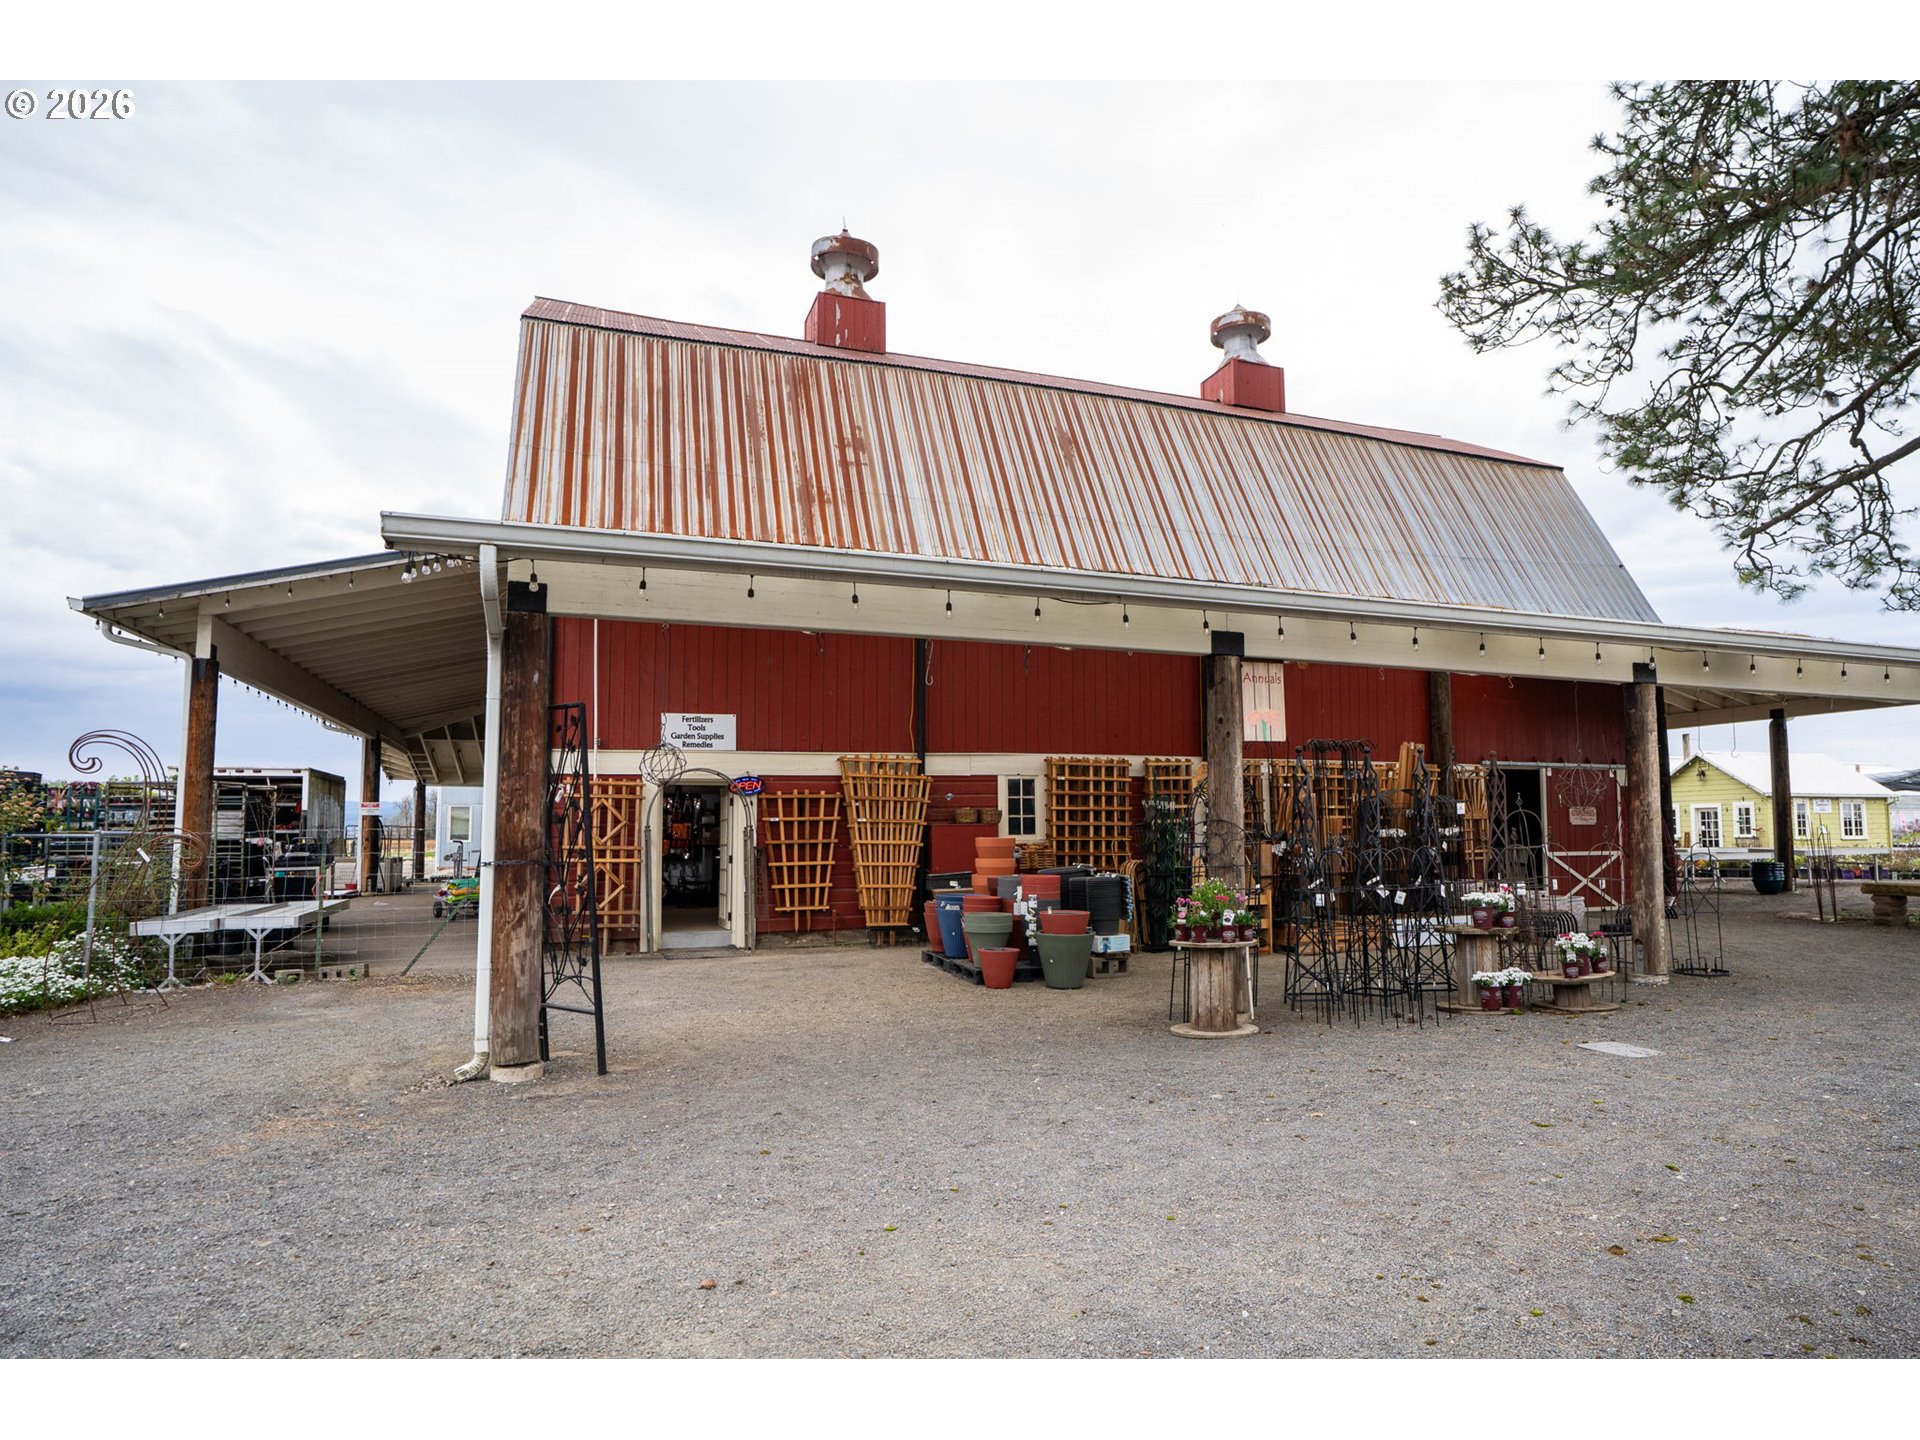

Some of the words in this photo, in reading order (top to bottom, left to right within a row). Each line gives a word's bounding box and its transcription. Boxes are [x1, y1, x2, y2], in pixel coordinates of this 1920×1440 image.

[1243, 672, 1281, 684] Annuals
[682, 715, 713, 723] Fertilizers
[671, 732, 695, 740] Garden
[697, 732, 724, 741] Supplies
[730, 780, 762, 792] OPEN
